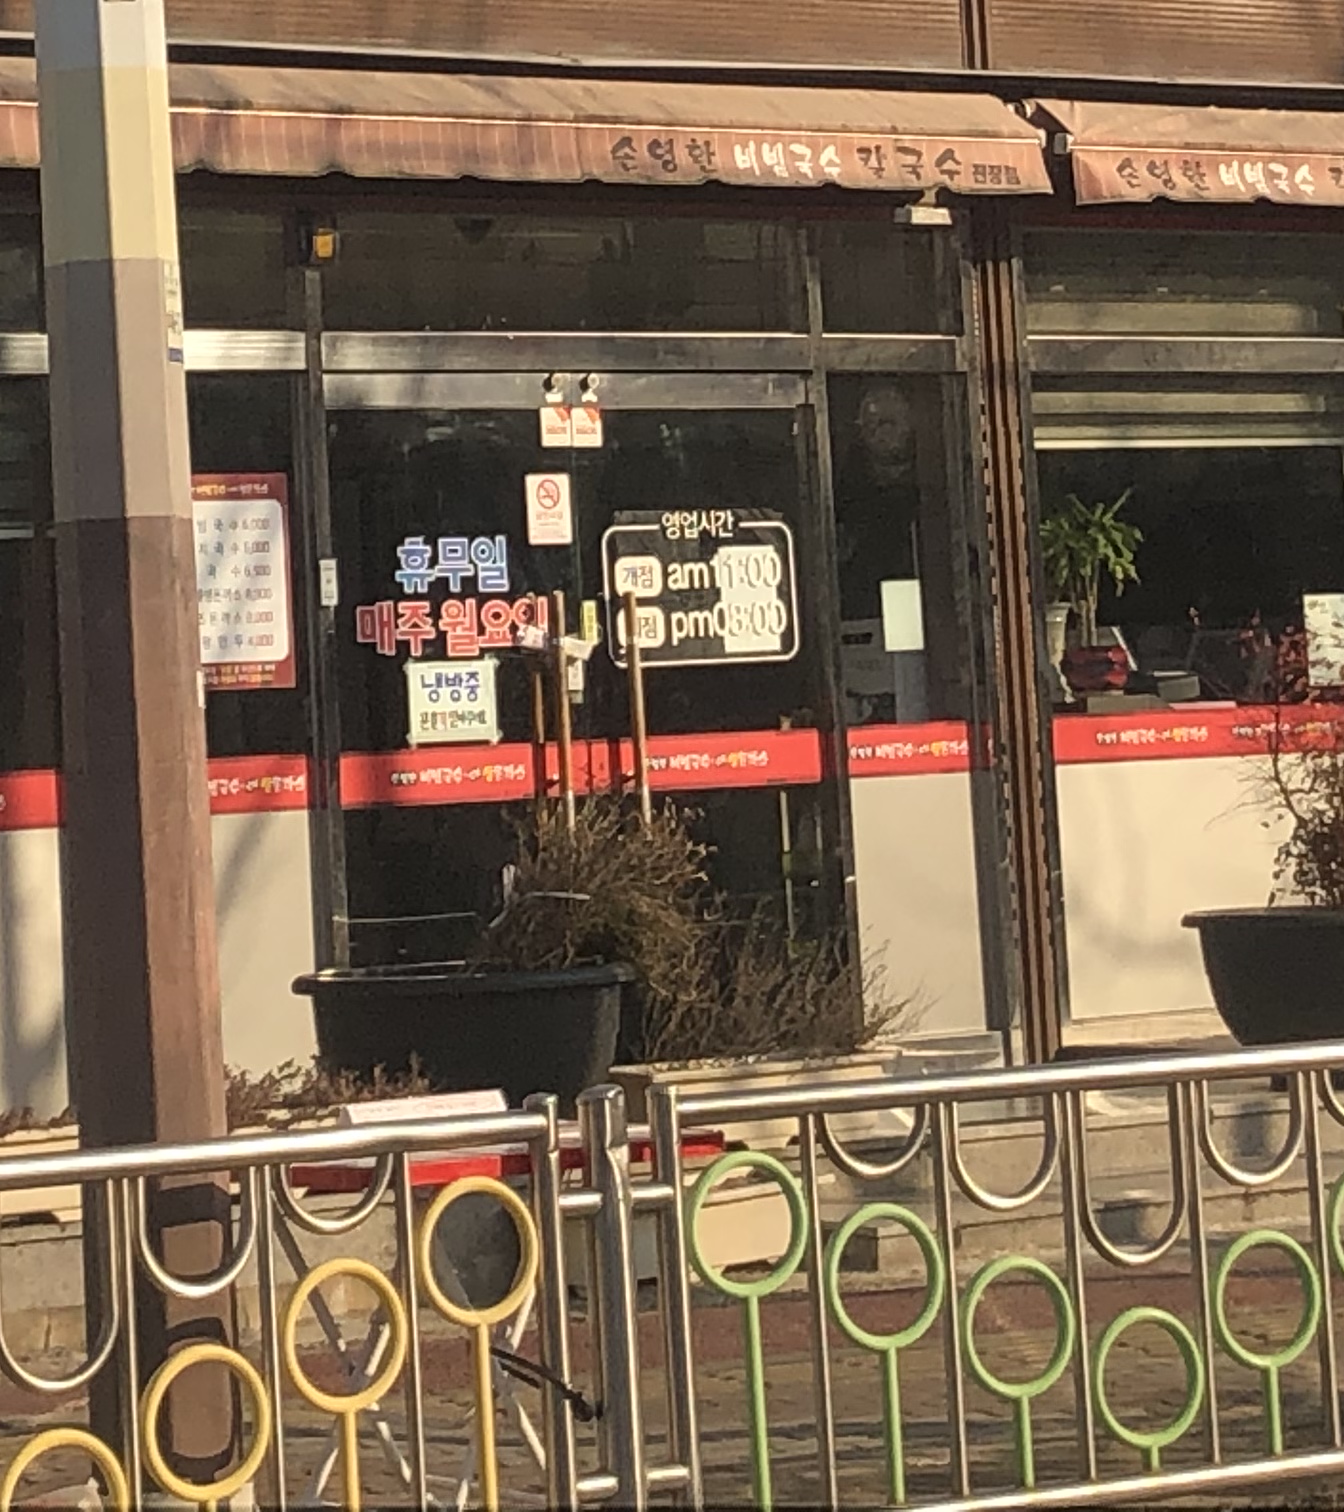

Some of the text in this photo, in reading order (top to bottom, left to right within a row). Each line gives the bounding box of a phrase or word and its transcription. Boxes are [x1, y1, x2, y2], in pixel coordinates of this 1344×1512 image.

[609, 135, 717, 173] 손영환
[732, 139, 843, 179] 비빔국수
[855, 143, 963, 182] 칼국수
[1216, 158, 1318, 196] 비빔국수
[661, 508, 736, 540] 영업시간
[394, 535, 512, 594] 휴무일
[622, 564, 654, 590] 개점
[356, 600, 437, 657] 매주
[420, 670, 481, 703] 냉방중
